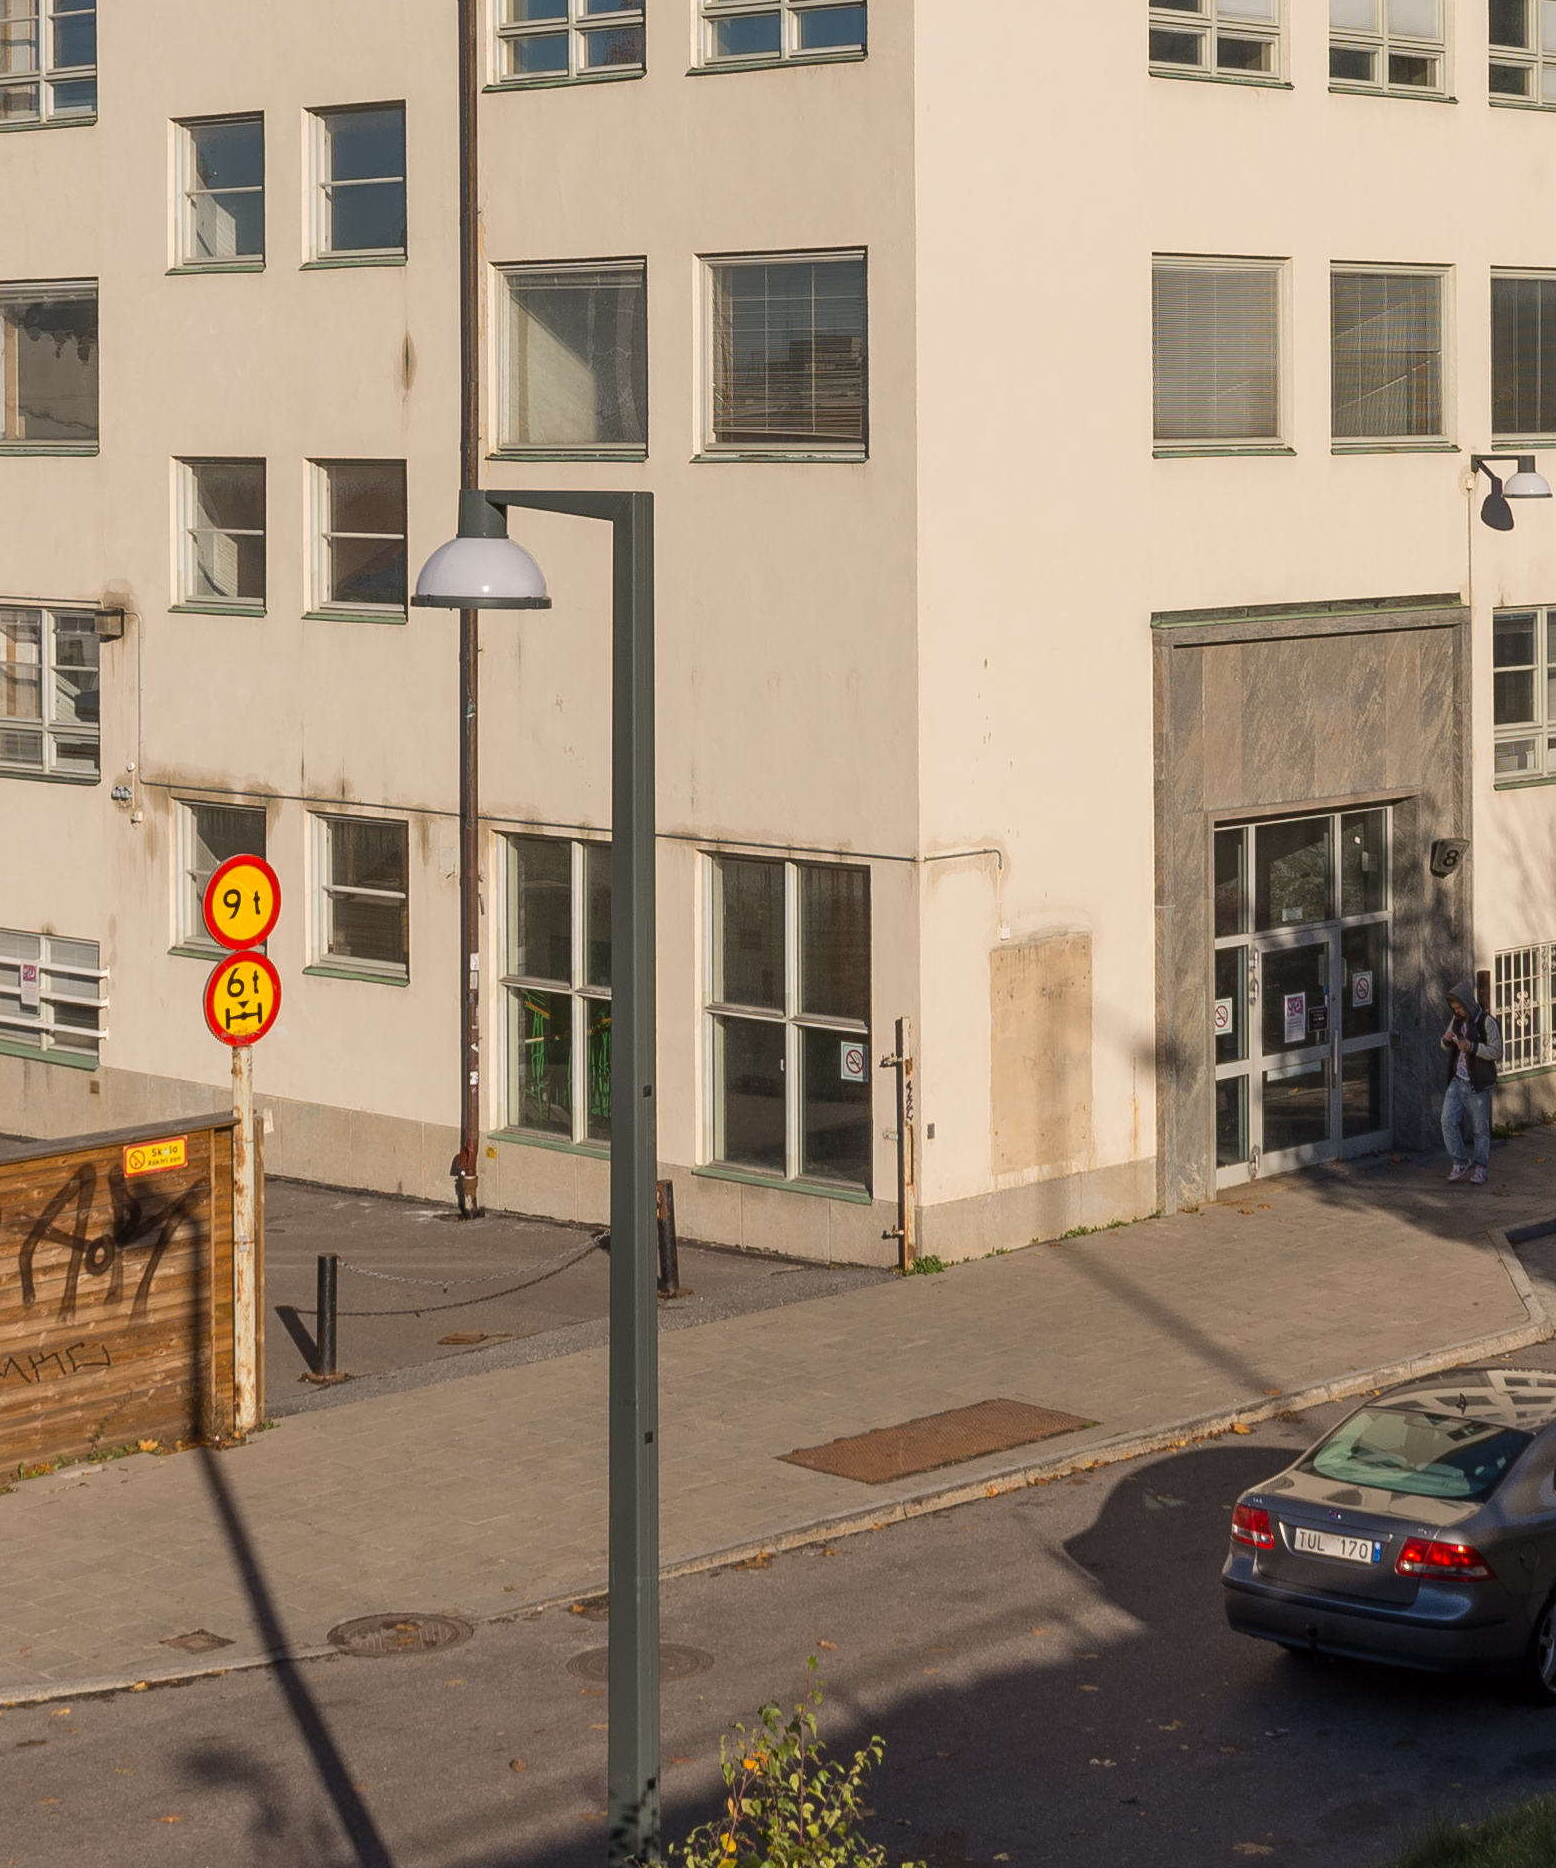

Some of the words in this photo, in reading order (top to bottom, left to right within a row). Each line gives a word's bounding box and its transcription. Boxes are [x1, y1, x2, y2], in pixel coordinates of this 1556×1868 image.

[1442, 848, 1460, 867] 8
[222, 888, 242, 920] 9
[253, 889, 261, 915] t
[226, 967, 245, 998] 6
[252, 969, 259, 994] t
[151, 1145, 178, 1157] Skla
[1299, 1531, 1325, 1552] TUL
[1340, 1539, 1369, 1560] 170
